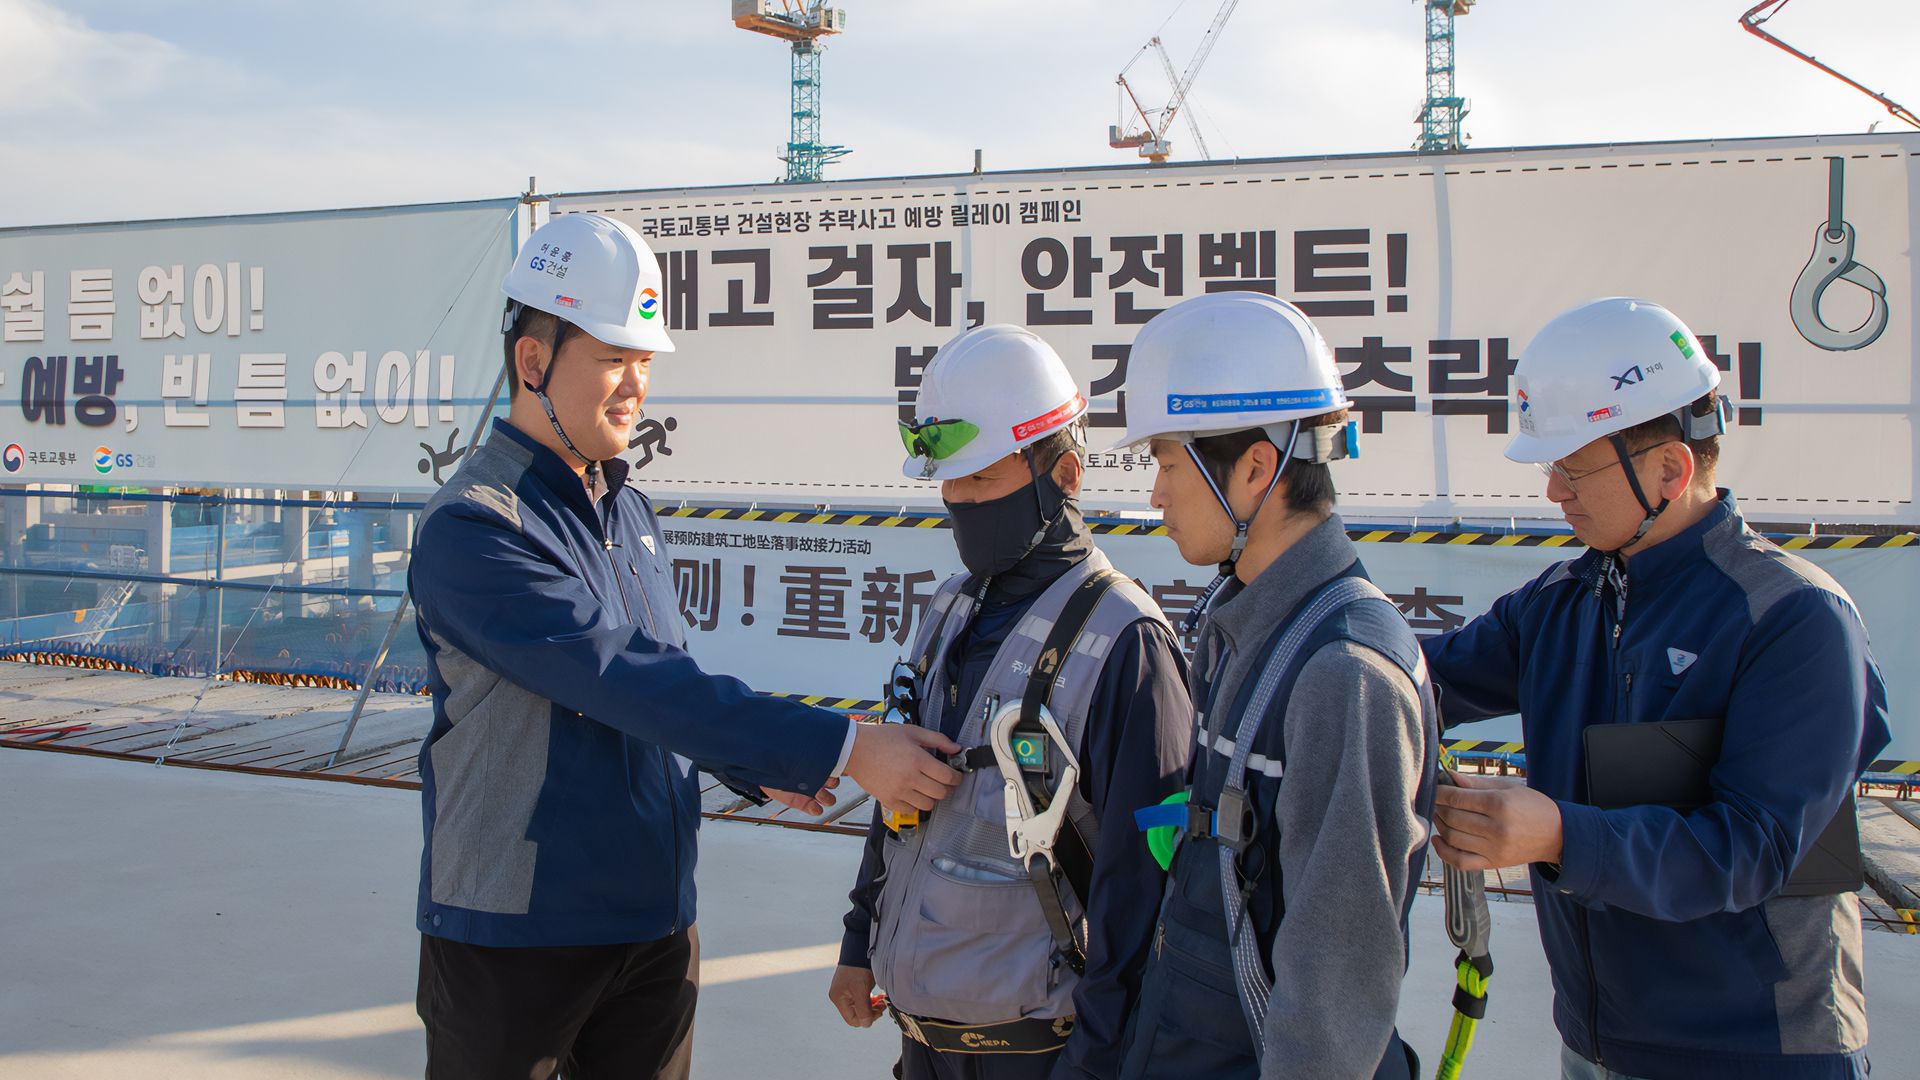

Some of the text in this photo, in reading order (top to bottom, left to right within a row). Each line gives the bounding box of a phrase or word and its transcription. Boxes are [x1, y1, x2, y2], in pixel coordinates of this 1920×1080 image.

[643, 199, 1081, 238] 국토교통부 건설현장 추락사고 예방 릴레이 캠페인
[1, 262, 264, 342] 쉴 틈 없이!
[807, 243, 986, 331] 걸자,
[1021, 228, 1408, 326] 안전벨트!
[21, 350, 455, 433] 예방, 빈 틈 없이!
[1334, 337, 1520, 434] 추락
[28, 451, 77, 466] 국토교통부
[116, 453, 133, 468] GS
[1085, 453, 1154, 472] 토교통부
